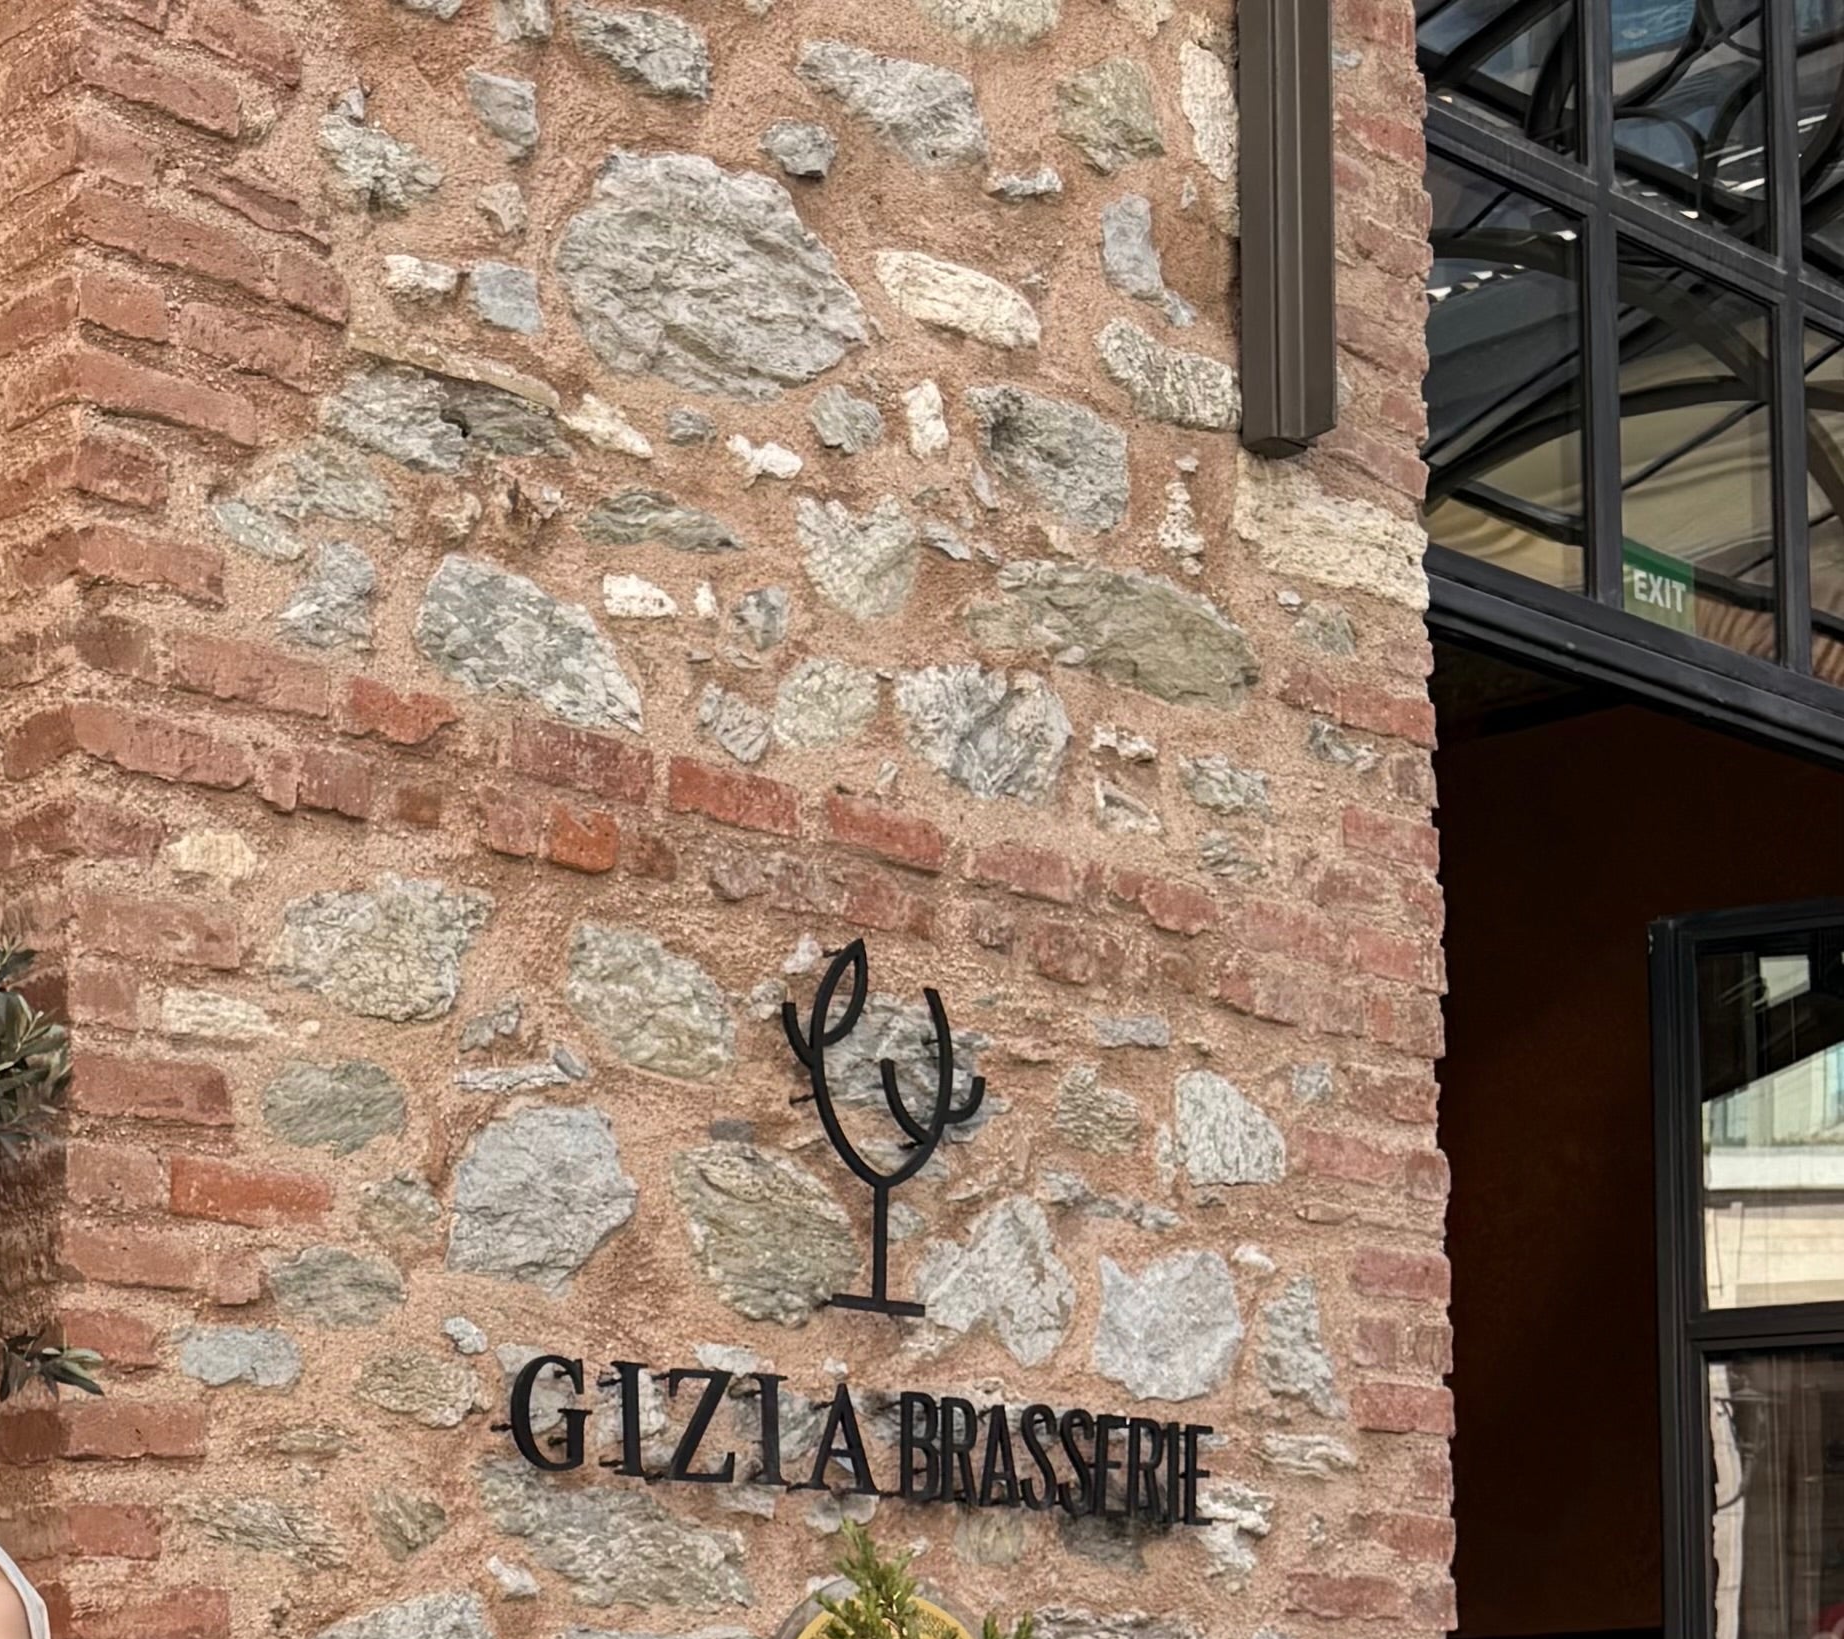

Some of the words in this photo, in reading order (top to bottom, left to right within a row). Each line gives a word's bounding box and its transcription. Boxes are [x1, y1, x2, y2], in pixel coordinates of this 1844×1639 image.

[1633, 568, 1687, 613] EXIT
[510, 1354, 880, 1494] GIZIA
[900, 1391, 1213, 1525] BRASSERIE
